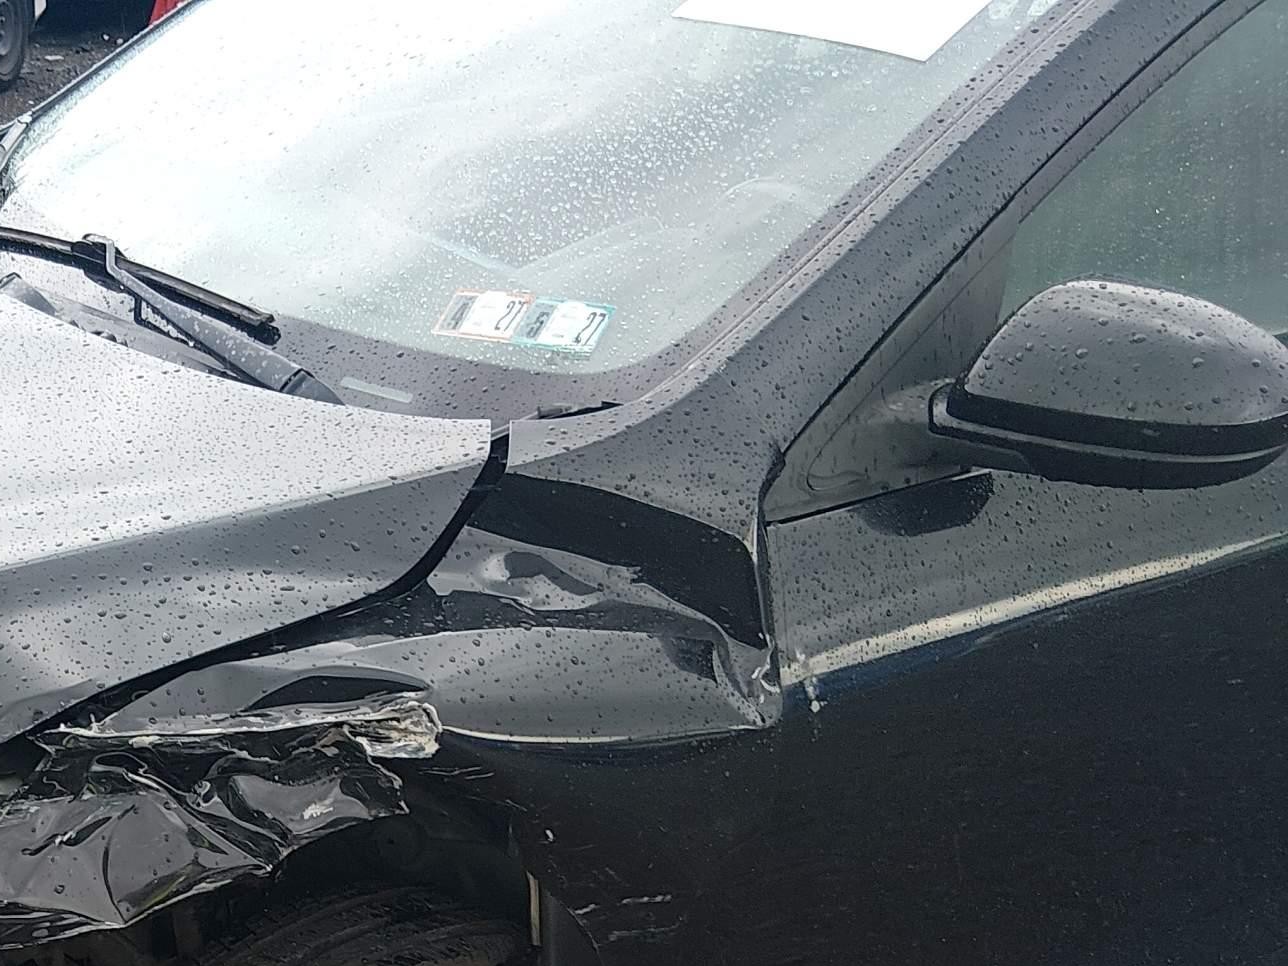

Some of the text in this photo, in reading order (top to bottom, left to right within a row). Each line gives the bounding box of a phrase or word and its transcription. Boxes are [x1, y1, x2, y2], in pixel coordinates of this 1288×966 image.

[494, 300, 528, 333] 27
[526, 311, 607, 346] 5 27
